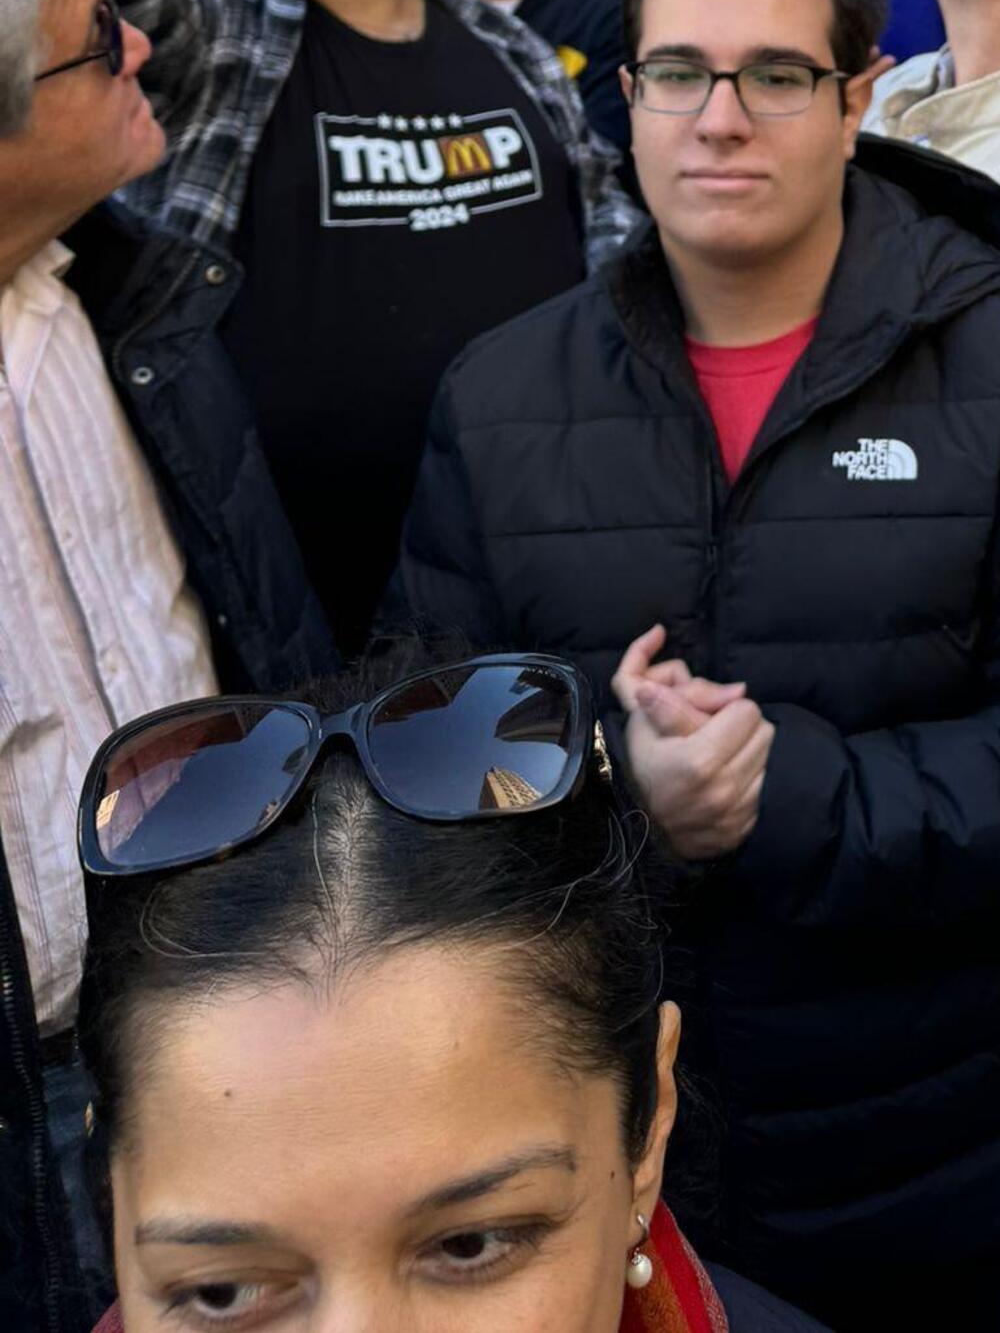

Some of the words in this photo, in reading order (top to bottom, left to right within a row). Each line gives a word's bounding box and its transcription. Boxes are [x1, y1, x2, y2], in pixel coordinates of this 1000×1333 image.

[328, 125, 523, 184] TRUMP
[376, 188, 443, 205] AMERICA
[443, 178, 491, 201] GREAT
[409, 203, 470, 231] 2024
[857, 438, 888, 452] THE
[832, 451, 888, 467] NORTH
[847, 466, 888, 481] FACE
